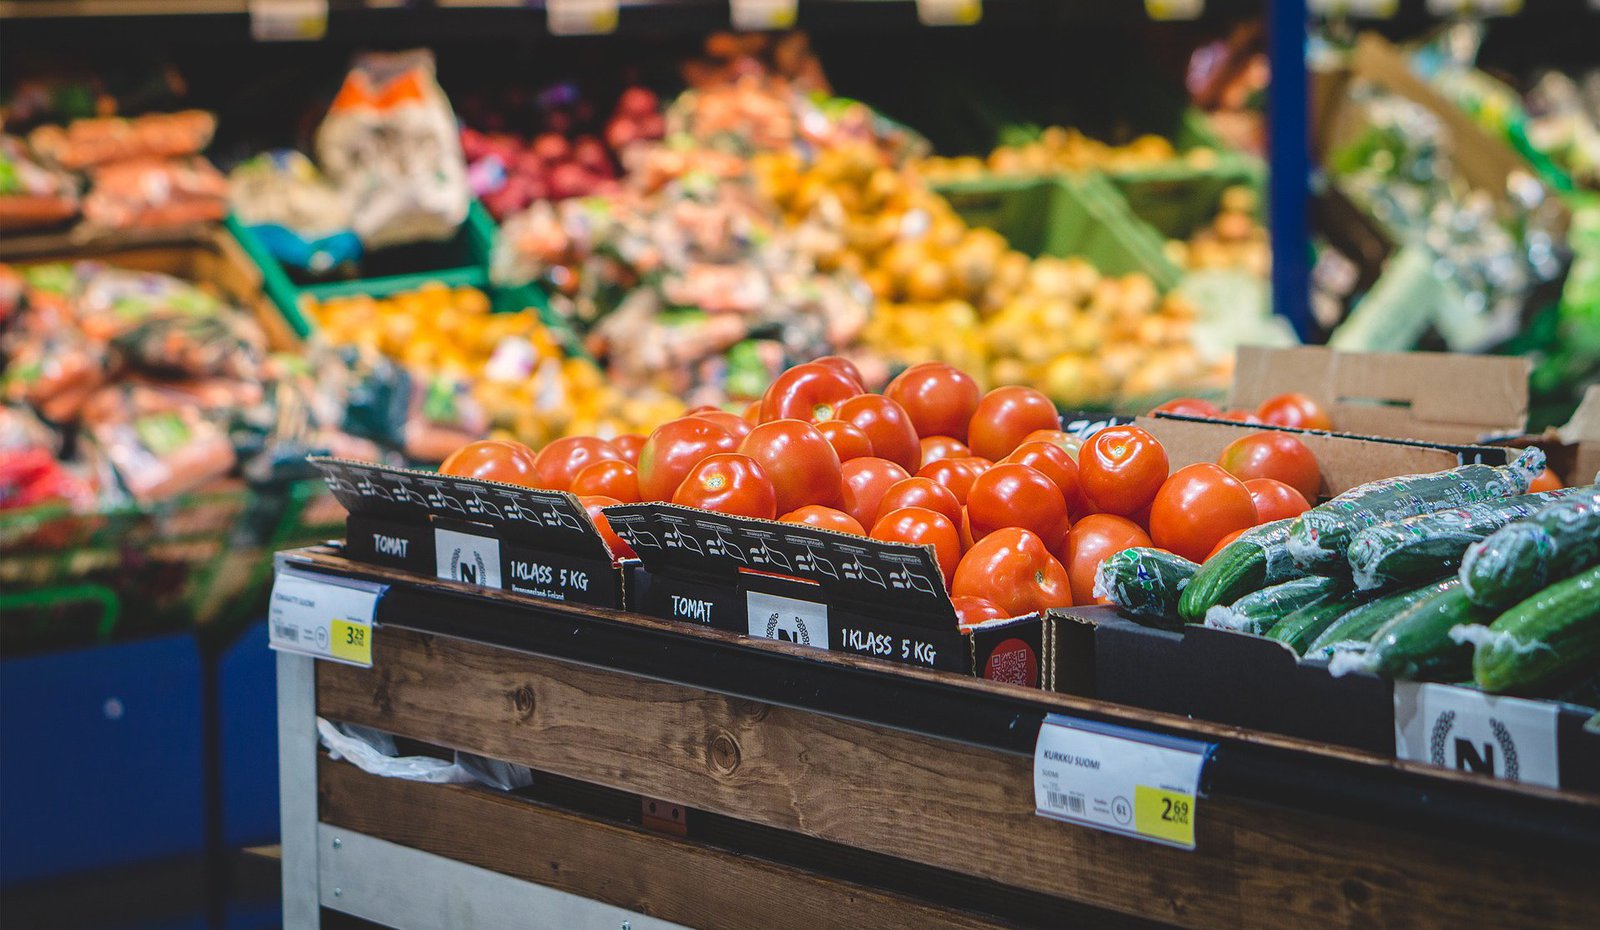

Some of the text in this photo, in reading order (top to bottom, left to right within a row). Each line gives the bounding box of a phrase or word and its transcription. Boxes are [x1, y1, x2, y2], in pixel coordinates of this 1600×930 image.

[373, 533, 408, 558] TOMAT
[460, 562, 477, 584] N
[510, 560, 516, 578] 1
[516, 561, 553, 584] KLASS
[560, 568, 568, 587] 5
[570, 569, 589, 592] KG
[671, 595, 714, 622] TOMAT
[841, 628, 937, 666] 1 KLASS 5 KG
[1043, 749, 1100, 770] KURKKU SUOMI
[1455, 739, 1494, 777] N
[1116, 803, 1127, 816] 61
